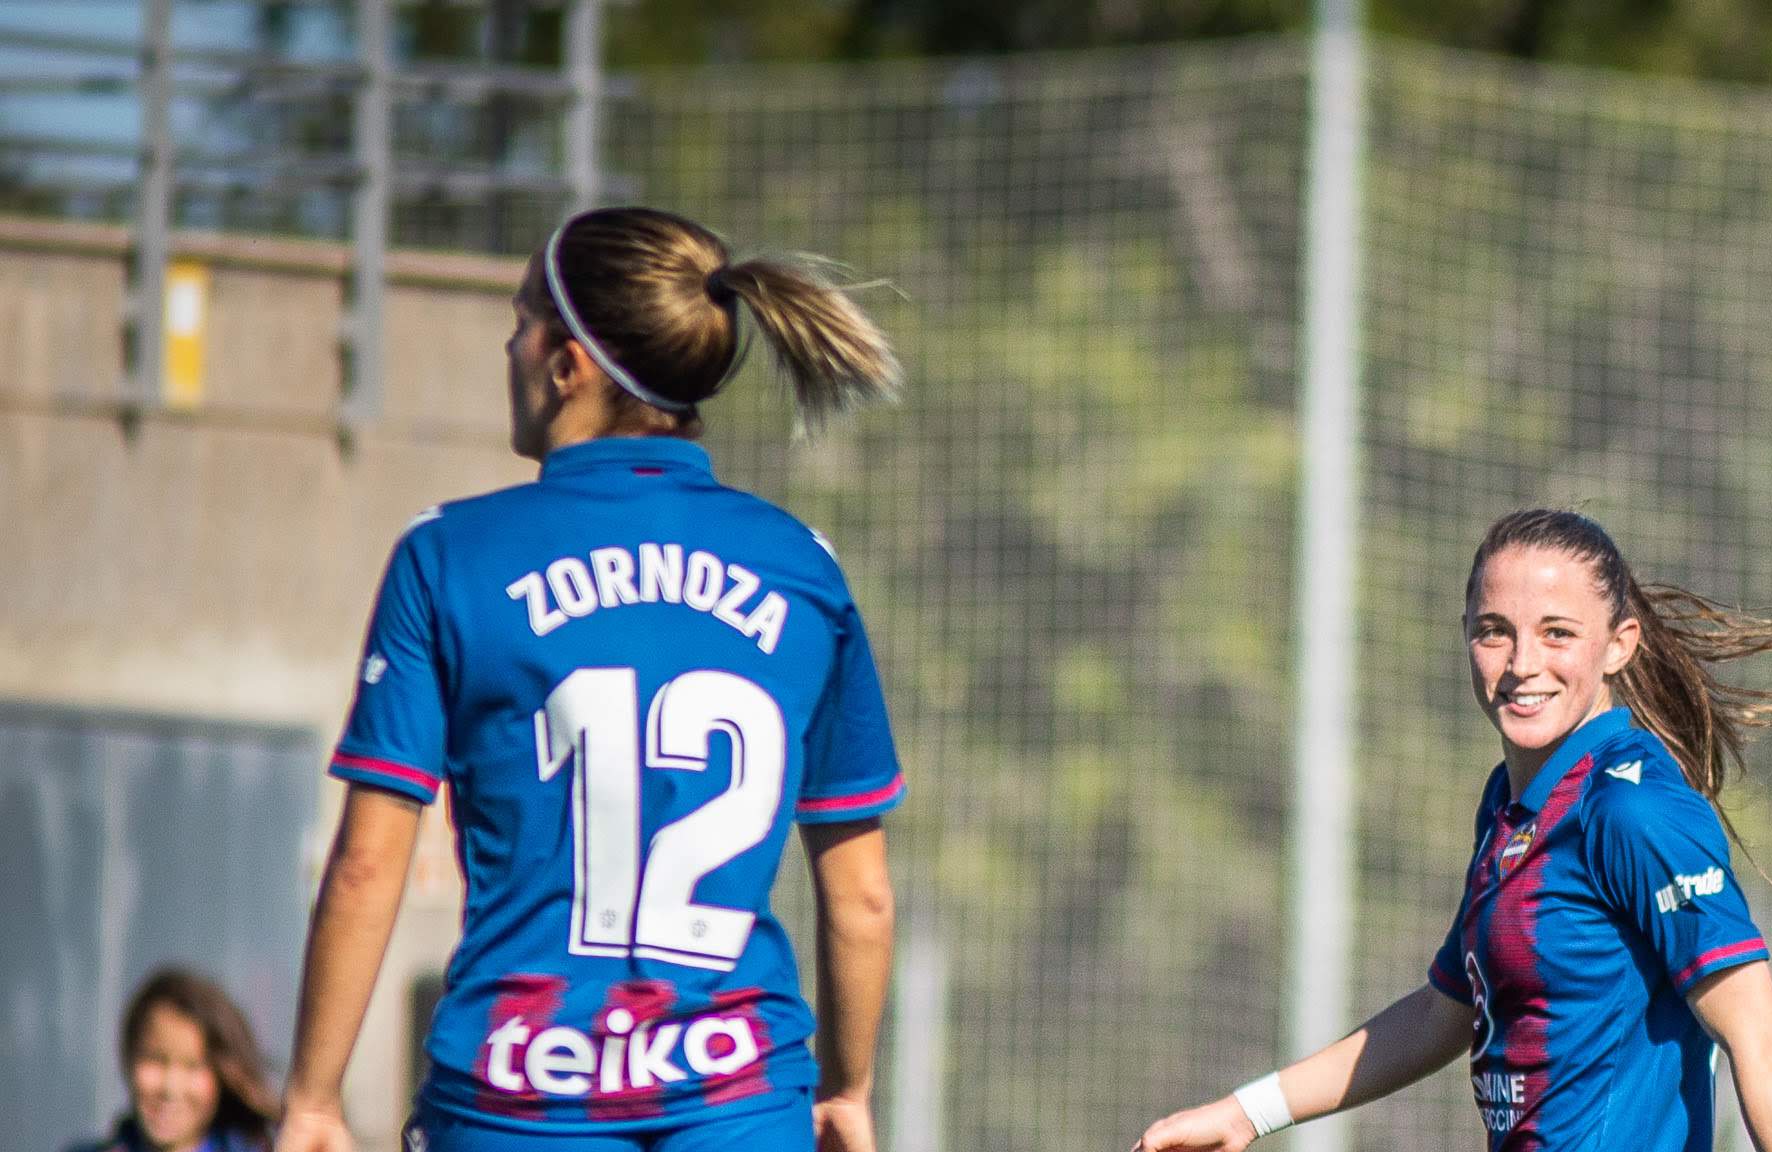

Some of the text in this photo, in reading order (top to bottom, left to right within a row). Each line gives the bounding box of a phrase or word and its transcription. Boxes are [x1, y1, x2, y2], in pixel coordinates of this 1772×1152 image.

[505, 541, 789, 655] ZORNOZA
[533, 666, 787, 972] 12
[486, 1008, 759, 1096] teika
